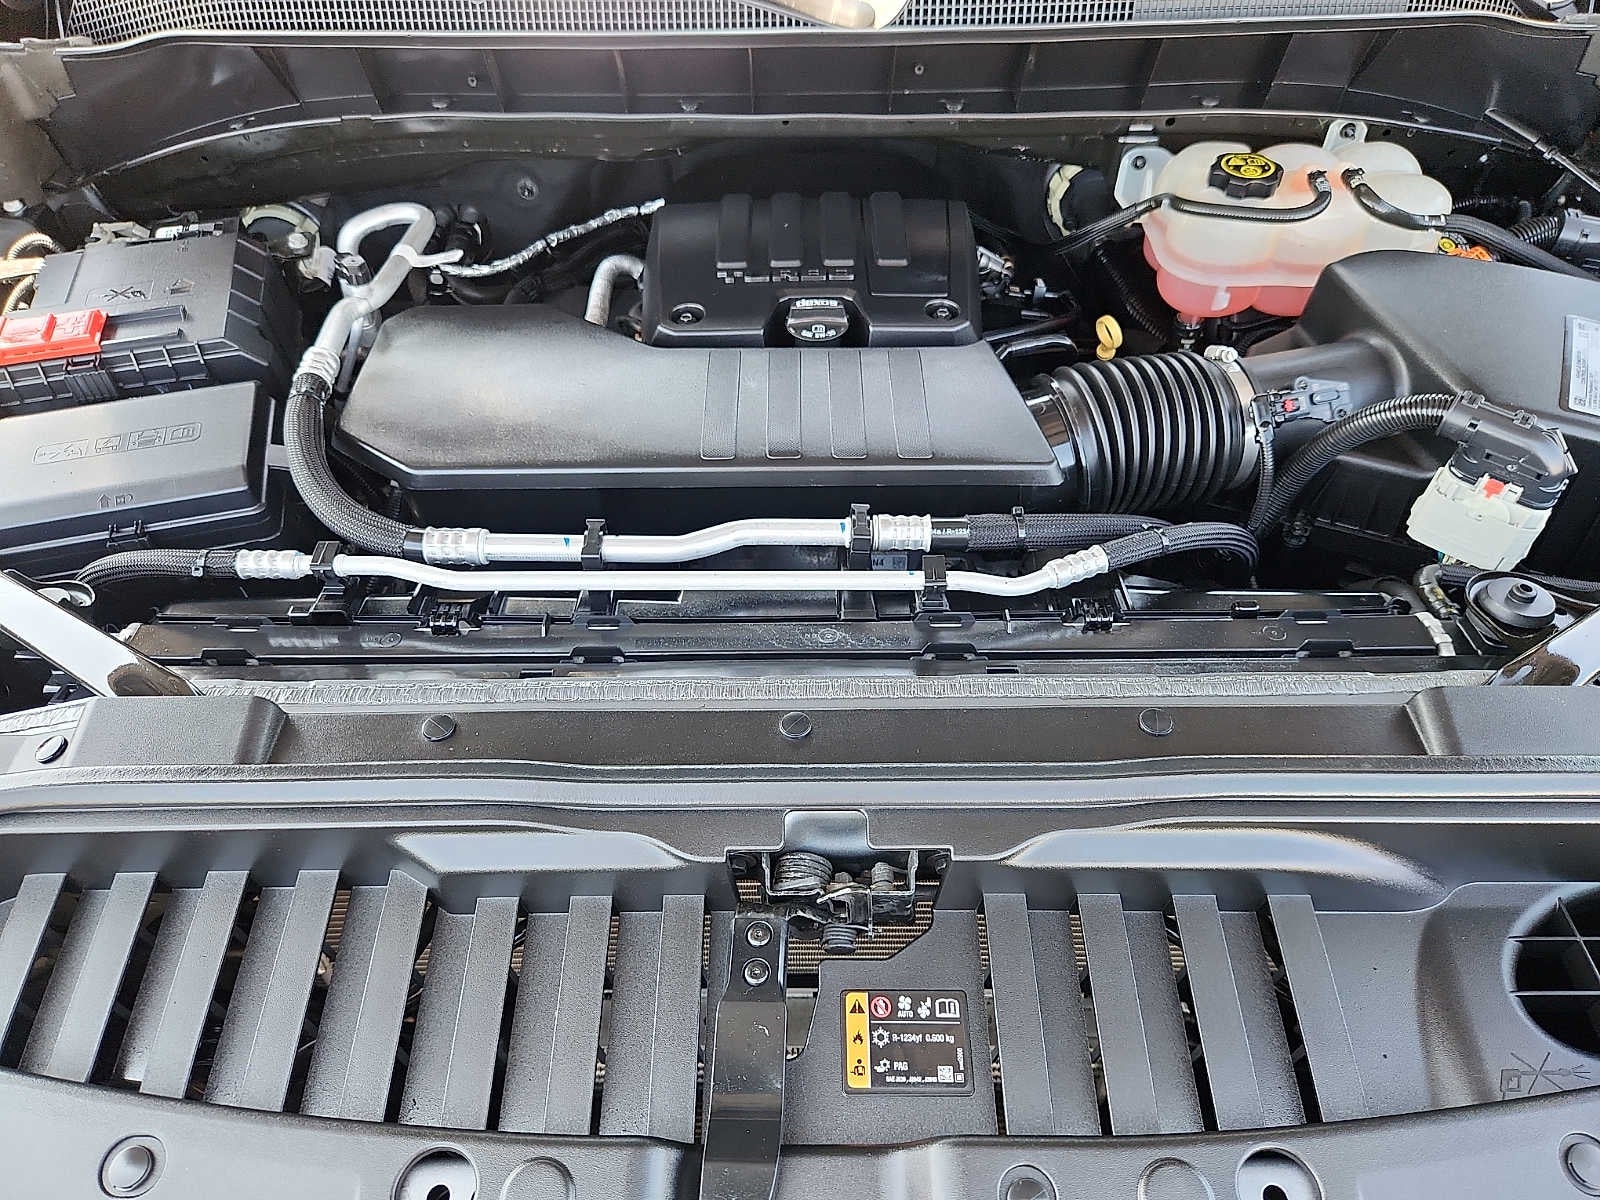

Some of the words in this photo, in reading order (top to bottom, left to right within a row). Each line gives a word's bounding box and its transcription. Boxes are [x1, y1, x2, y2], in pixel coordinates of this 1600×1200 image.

[897, 1010, 914, 1018] AUTO
[945, 1034, 955, 1044] kg
[893, 1061, 909, 1071] PAG
